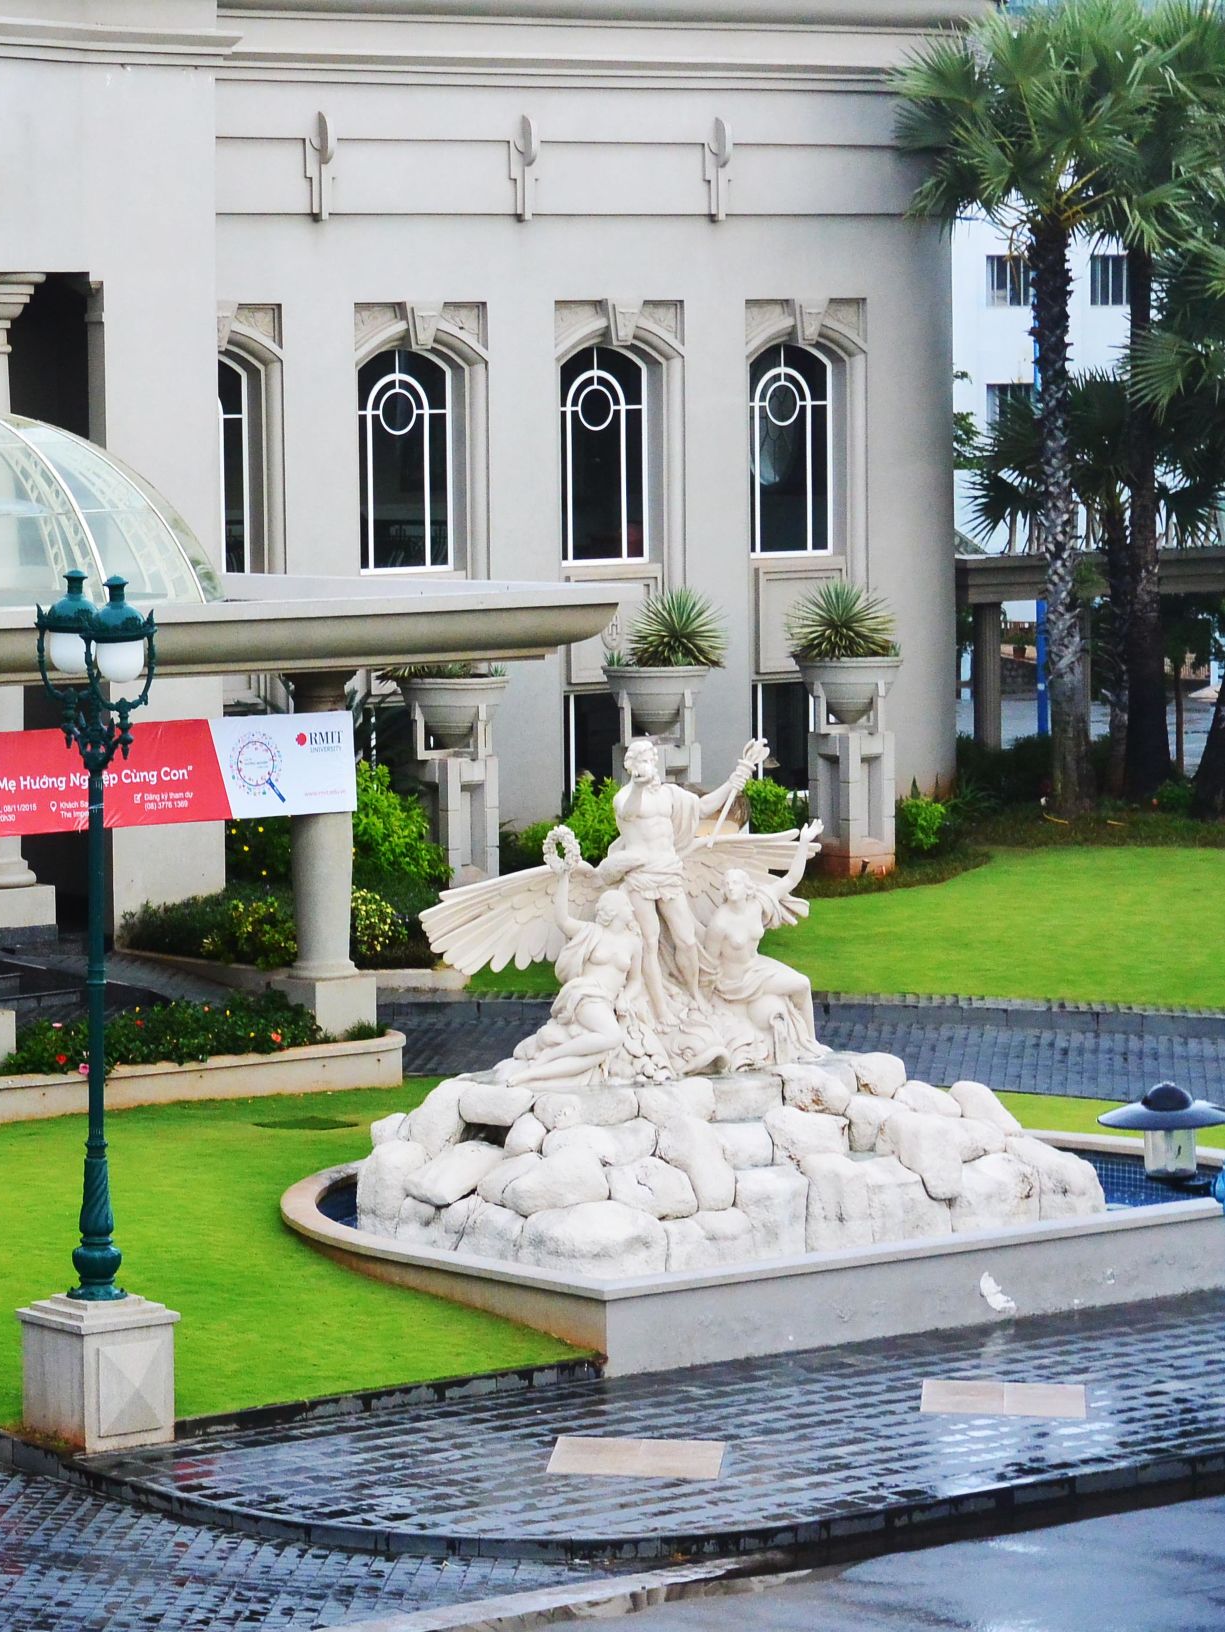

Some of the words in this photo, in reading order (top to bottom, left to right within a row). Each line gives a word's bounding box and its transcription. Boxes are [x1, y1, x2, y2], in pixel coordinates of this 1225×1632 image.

[309, 731, 343, 745] RMIT
[69, 770, 118, 789] Ngệp
[121, 769, 157, 785] Cùng
